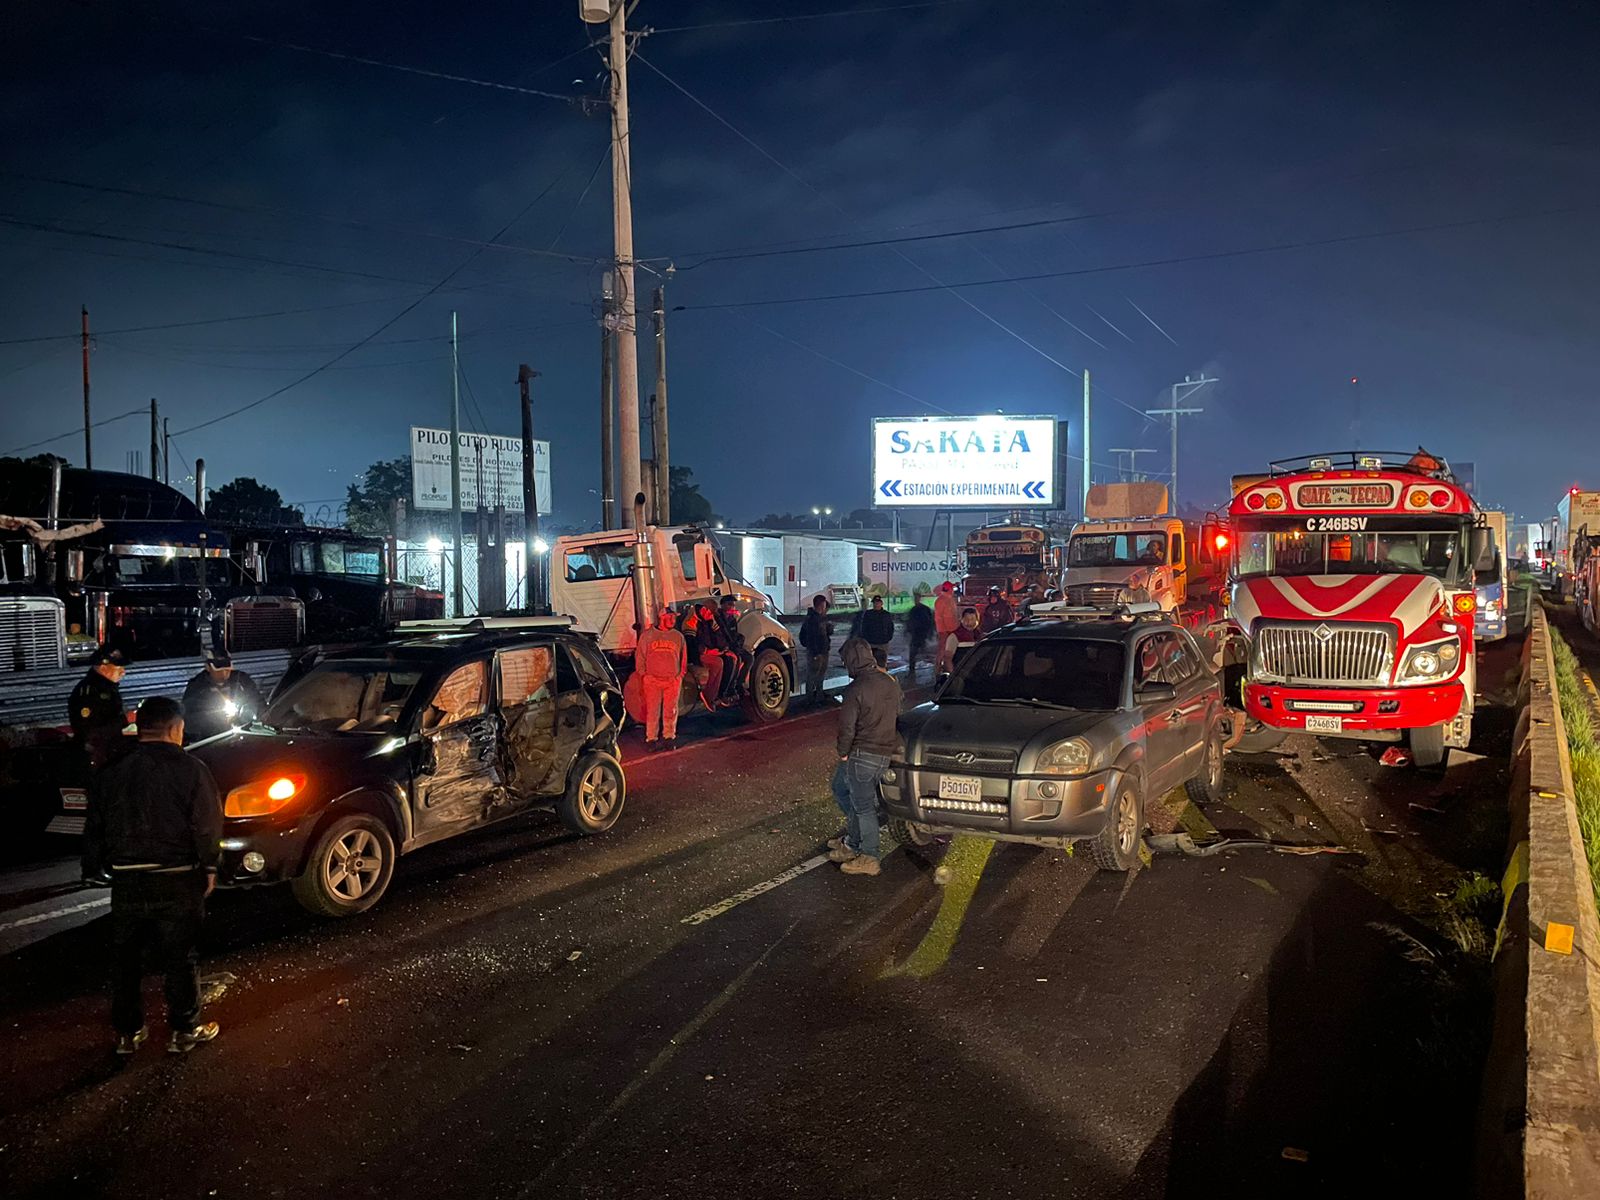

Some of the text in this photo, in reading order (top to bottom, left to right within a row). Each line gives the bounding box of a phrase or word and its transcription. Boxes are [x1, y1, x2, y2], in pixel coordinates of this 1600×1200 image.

[417, 430, 488, 450] PILOCITO
[951, 483, 1021, 496] EXPERIMENTAL
[1306, 517, 1368, 531] C 246BSV
[871, 561, 928, 572] BIENVENIDO
[941, 781, 979, 796] P501GXY
